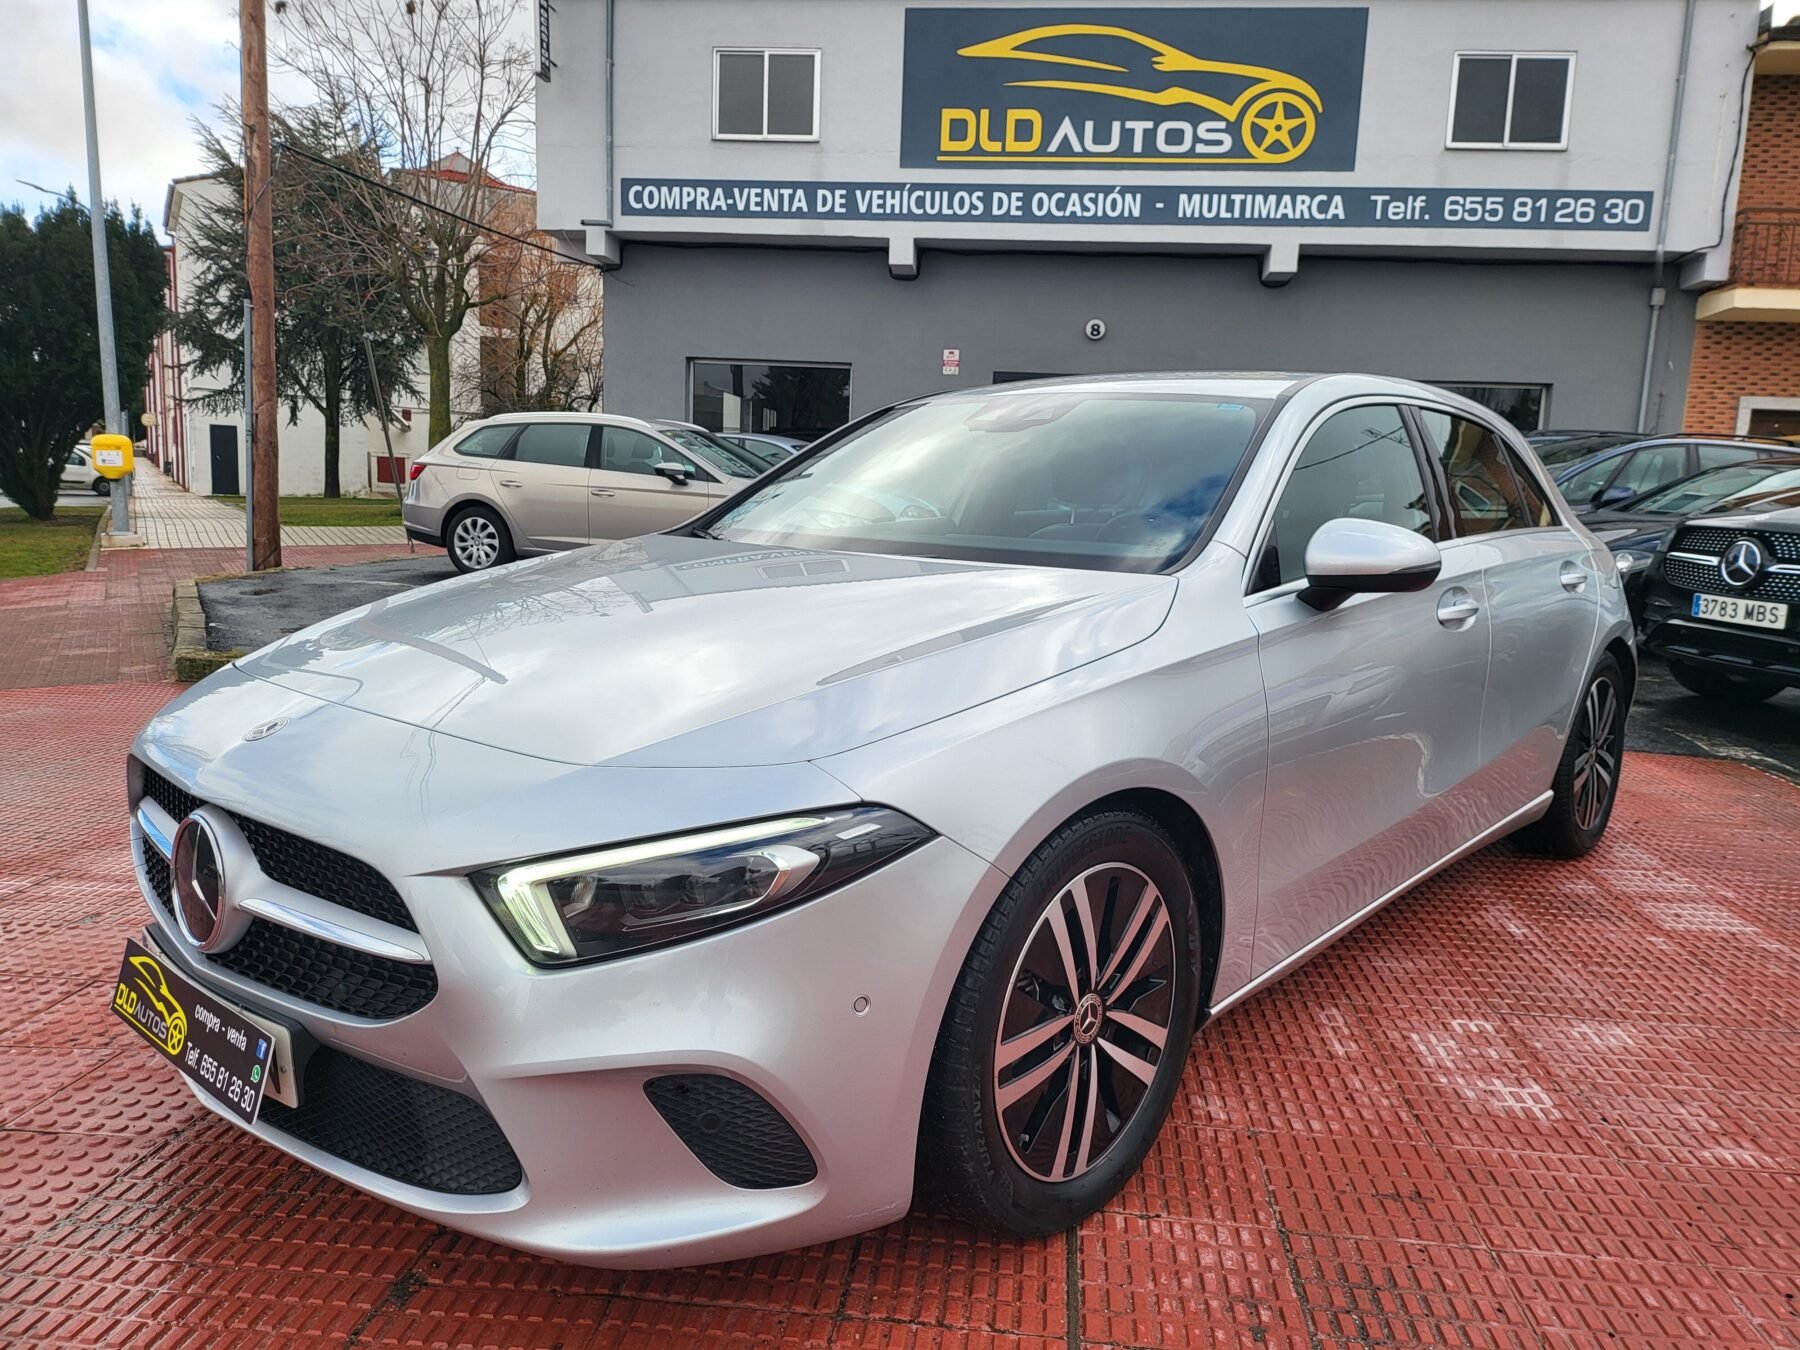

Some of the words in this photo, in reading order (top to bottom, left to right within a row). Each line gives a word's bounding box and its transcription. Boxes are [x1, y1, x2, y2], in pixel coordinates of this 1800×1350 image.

[939, 108, 1042, 152] DLD
[1046, 115, 1233, 154] AUTOS
[628, 185, 808, 213] COMPRA-VENTA
[816, 189, 846, 214] DE
[855, 184, 984, 216] VEHÍCULOS
[992, 191, 1023, 216] DE
[1031, 187, 1141, 218] OCASIÓN
[1177, 193, 1346, 220] MULTIMARCA
[1370, 195, 1430, 220] Telf.
[1443, 196, 1504, 222] 655
[1603, 199, 1645, 225] 30
[1090, 323, 1101, 337] 8
[1701, 598, 1739, 619] 3783
[1743, 603, 1780, 624] MBS
[115, 983, 137, 1015] DLD
[134, 1003, 168, 1040] AUTOS
[194, 1003, 221, 1033] compra
[226, 1025, 247, 1052] venta
[185, 1041, 198, 1069] Telf.
[200, 1054, 218, 1082] 655
[216, 1067, 229, 1092] 81
[228, 1076, 243, 1102] 26
[241, 1089, 255, 1113] 30
